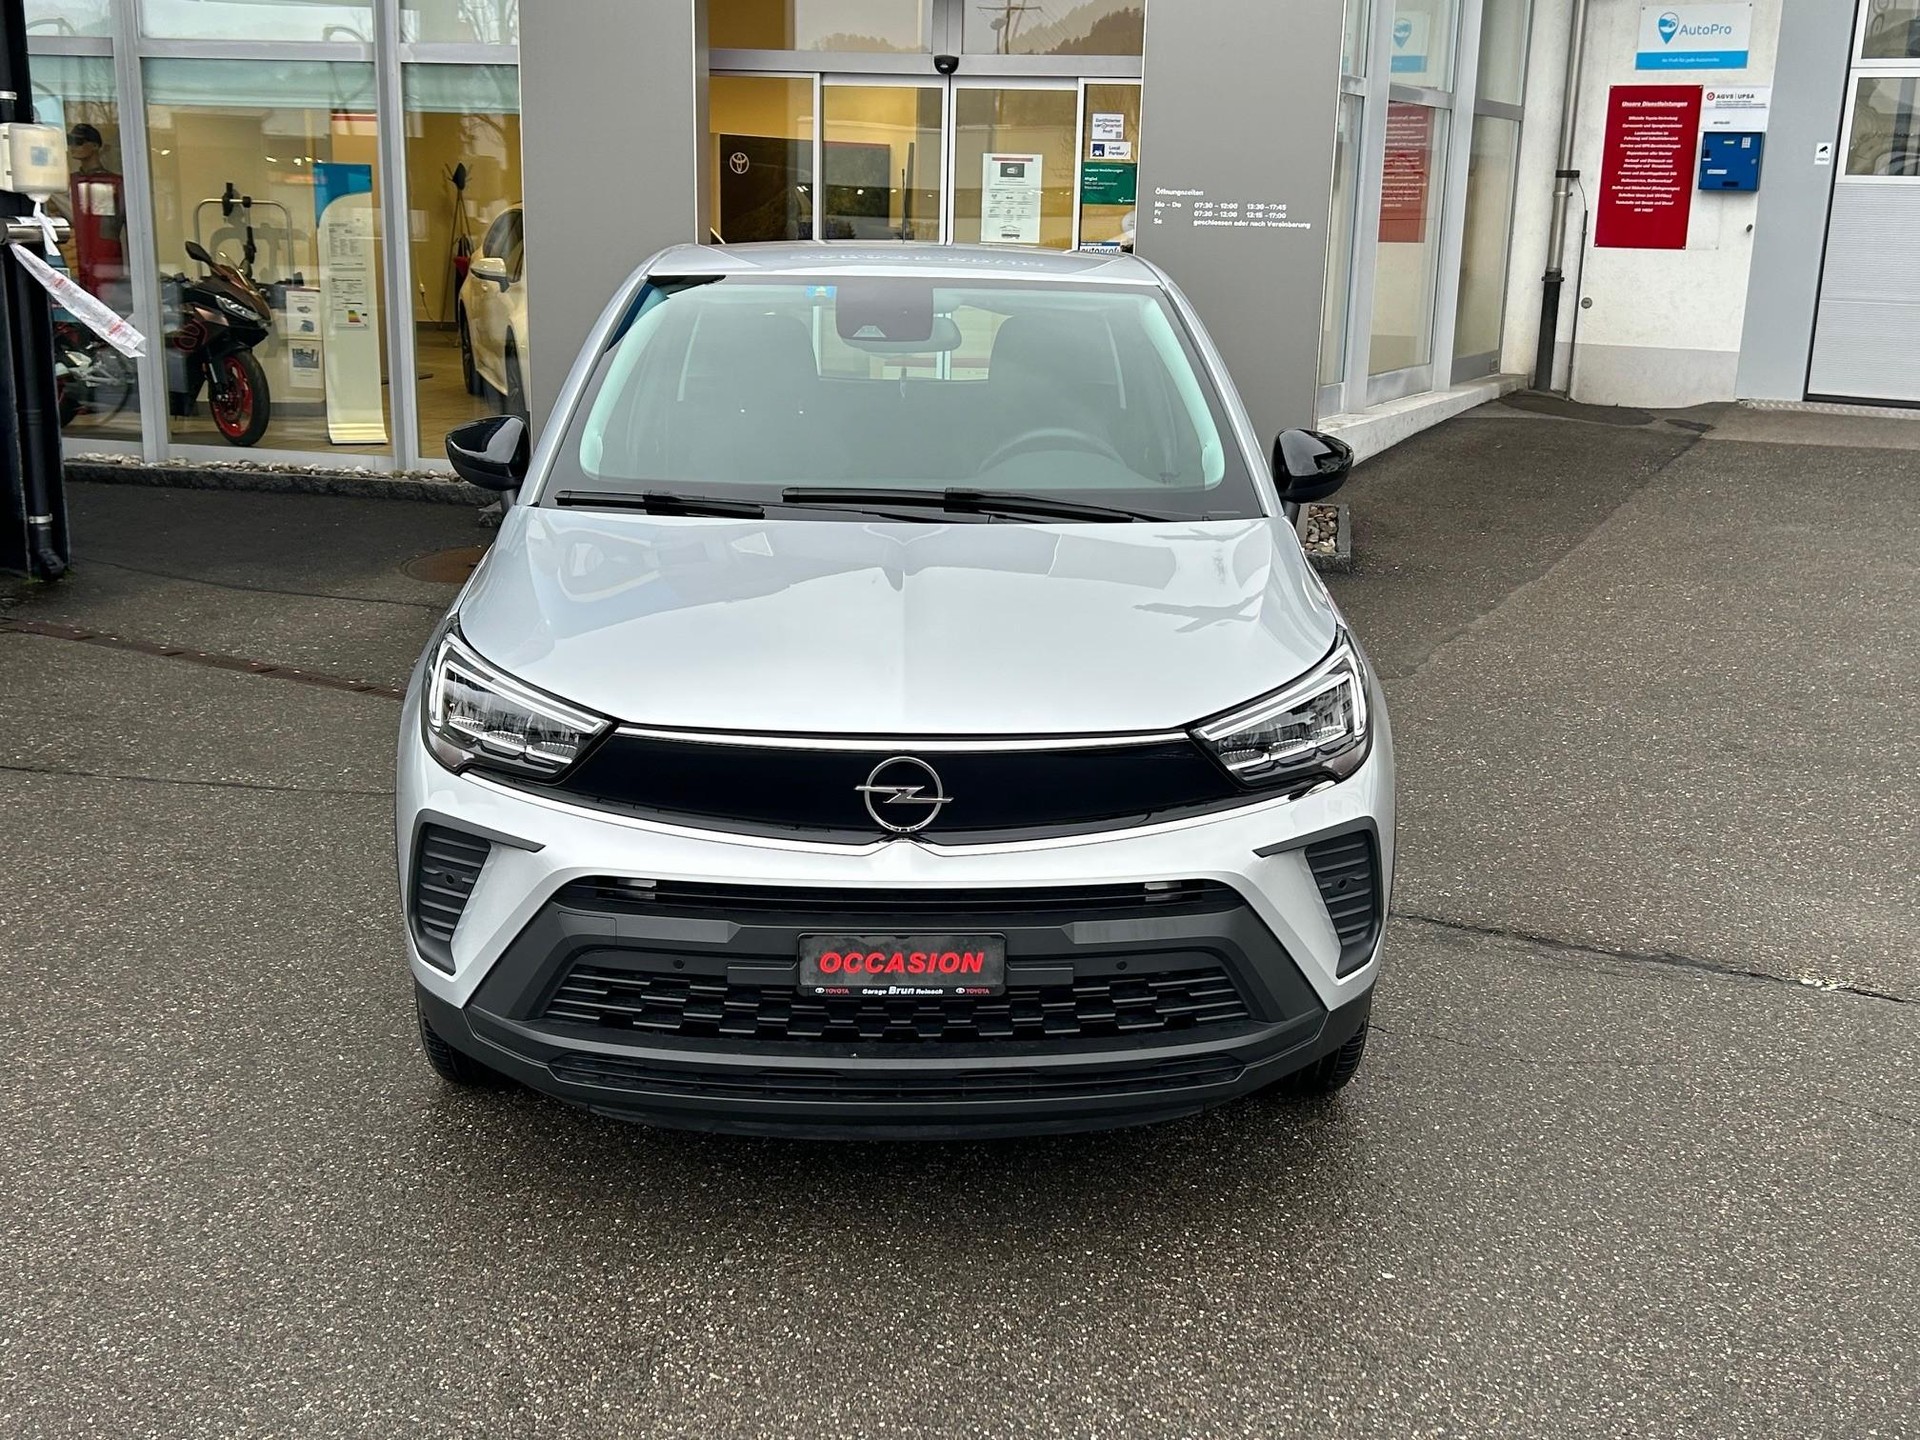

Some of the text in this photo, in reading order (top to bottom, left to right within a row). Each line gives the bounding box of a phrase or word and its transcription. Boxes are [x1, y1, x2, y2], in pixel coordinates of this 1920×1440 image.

[1679, 23, 1732, 36] AutoPro
[1155, 187, 1204, 196] Öffnungszeiten
[1193, 219, 1233, 227] geschlossen
[1266, 220, 1311, 229] Vereinbarung
[819, 951, 985, 974] OCCASION
[862, 988, 887, 996] Garage
[888, 985, 915, 995] Brun
